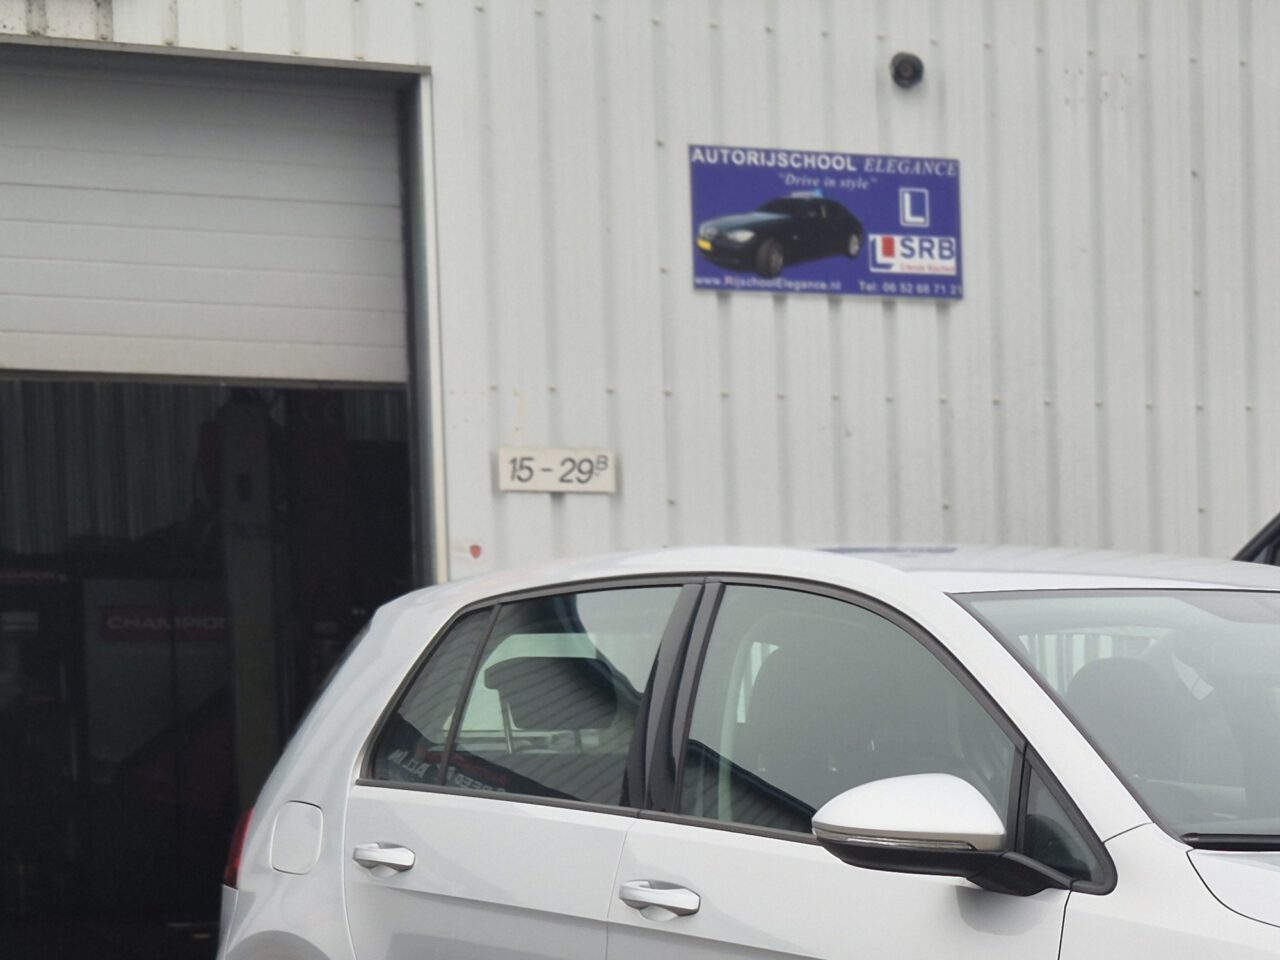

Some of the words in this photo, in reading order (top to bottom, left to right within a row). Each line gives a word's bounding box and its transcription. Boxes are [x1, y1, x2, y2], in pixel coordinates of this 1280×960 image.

[691, 147, 857, 172] AUTORIJSCHOOL
[863, 157, 959, 177] ELEGANCE
[823, 176, 836, 188] in
[900, 236, 955, 260] SRB
